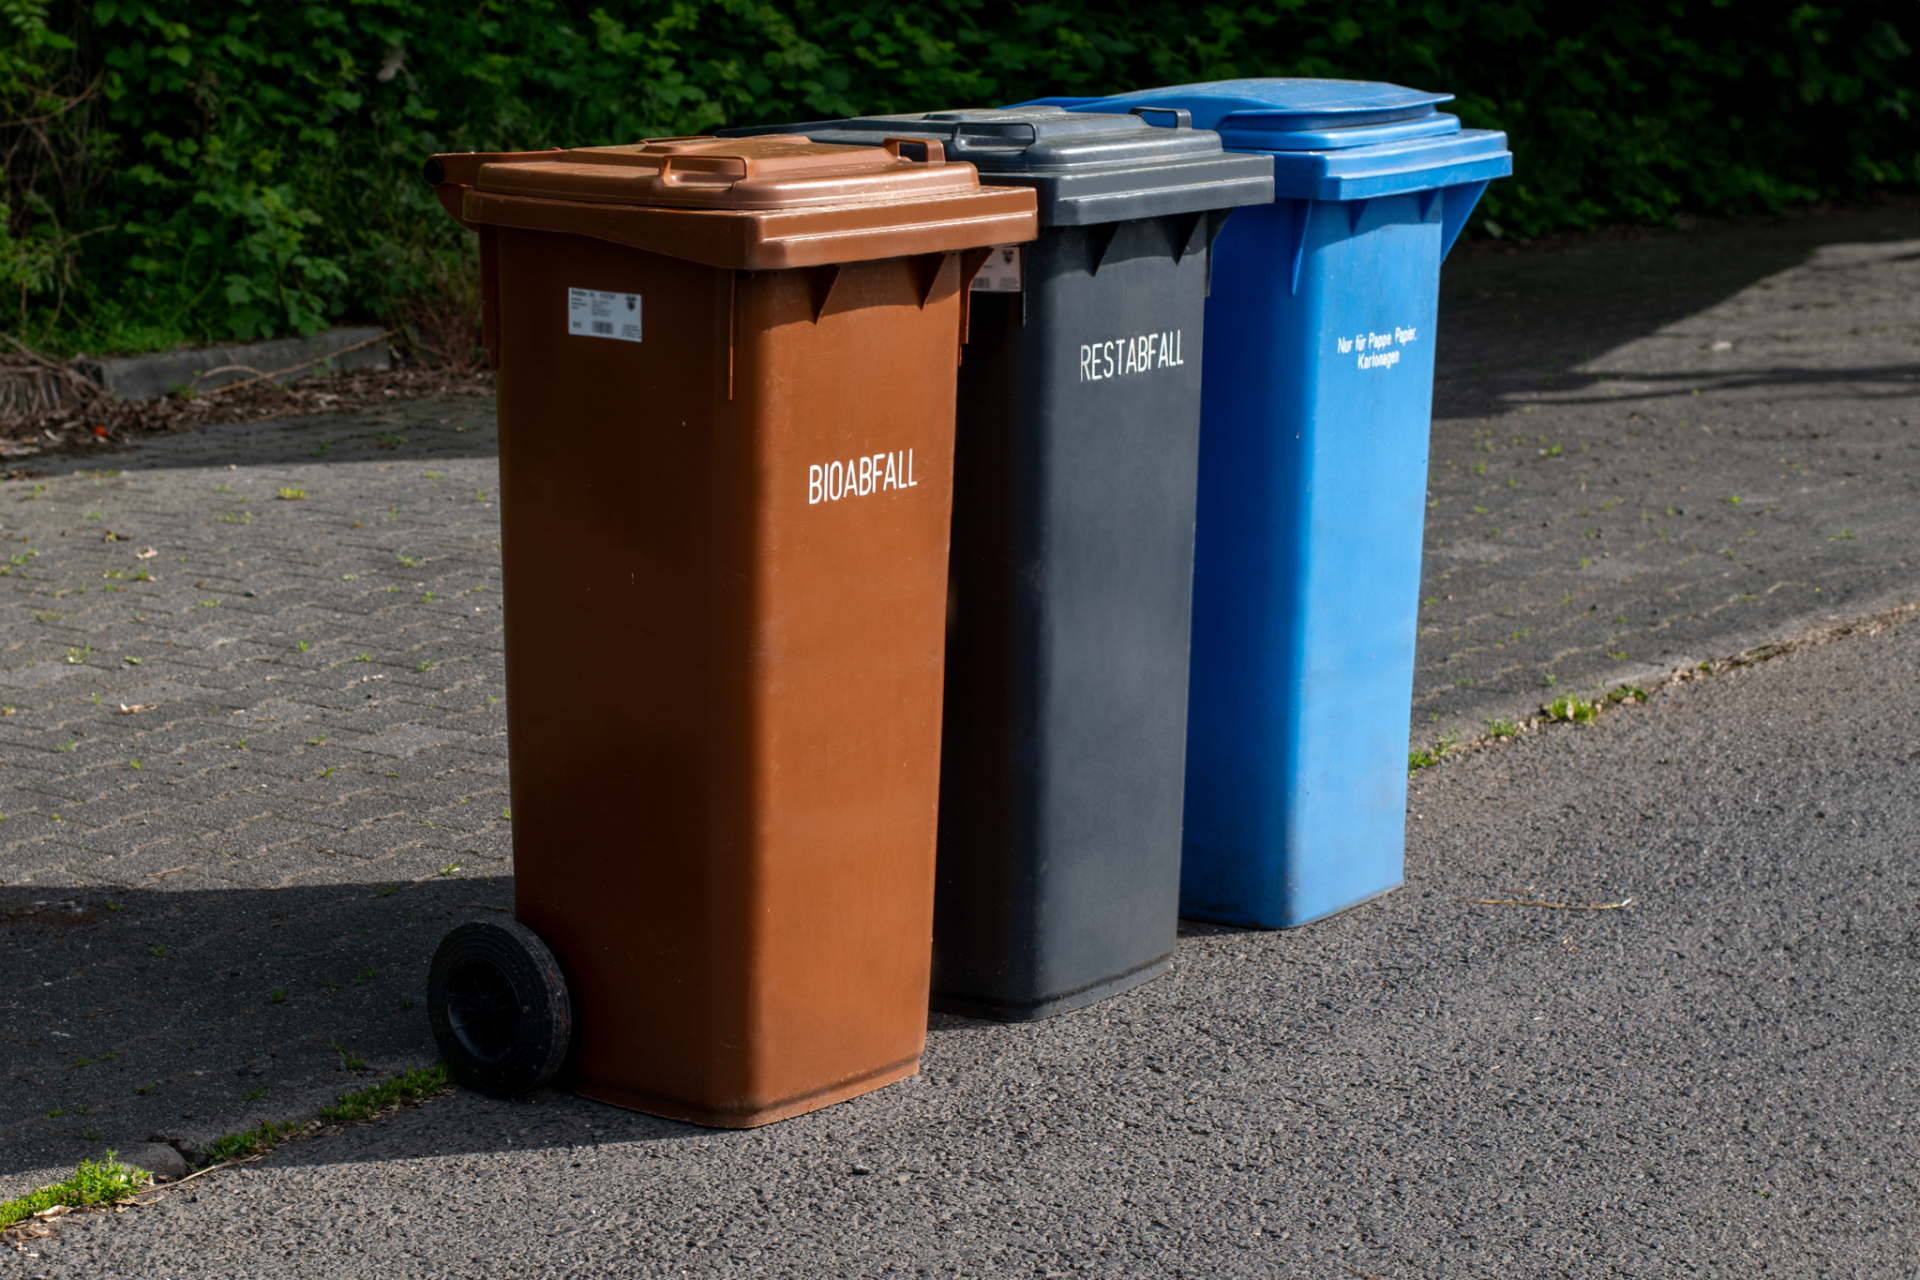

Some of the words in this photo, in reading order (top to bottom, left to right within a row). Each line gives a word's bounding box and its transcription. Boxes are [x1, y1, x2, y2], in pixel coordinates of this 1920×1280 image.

[1080, 329, 1184, 383] RESTABFALL
[1337, 336, 1354, 354] Nur
[1354, 334, 1367, 352] für
[1357, 350, 1400, 370] Kartonagen
[808, 448, 918, 505] BIOABFALL
